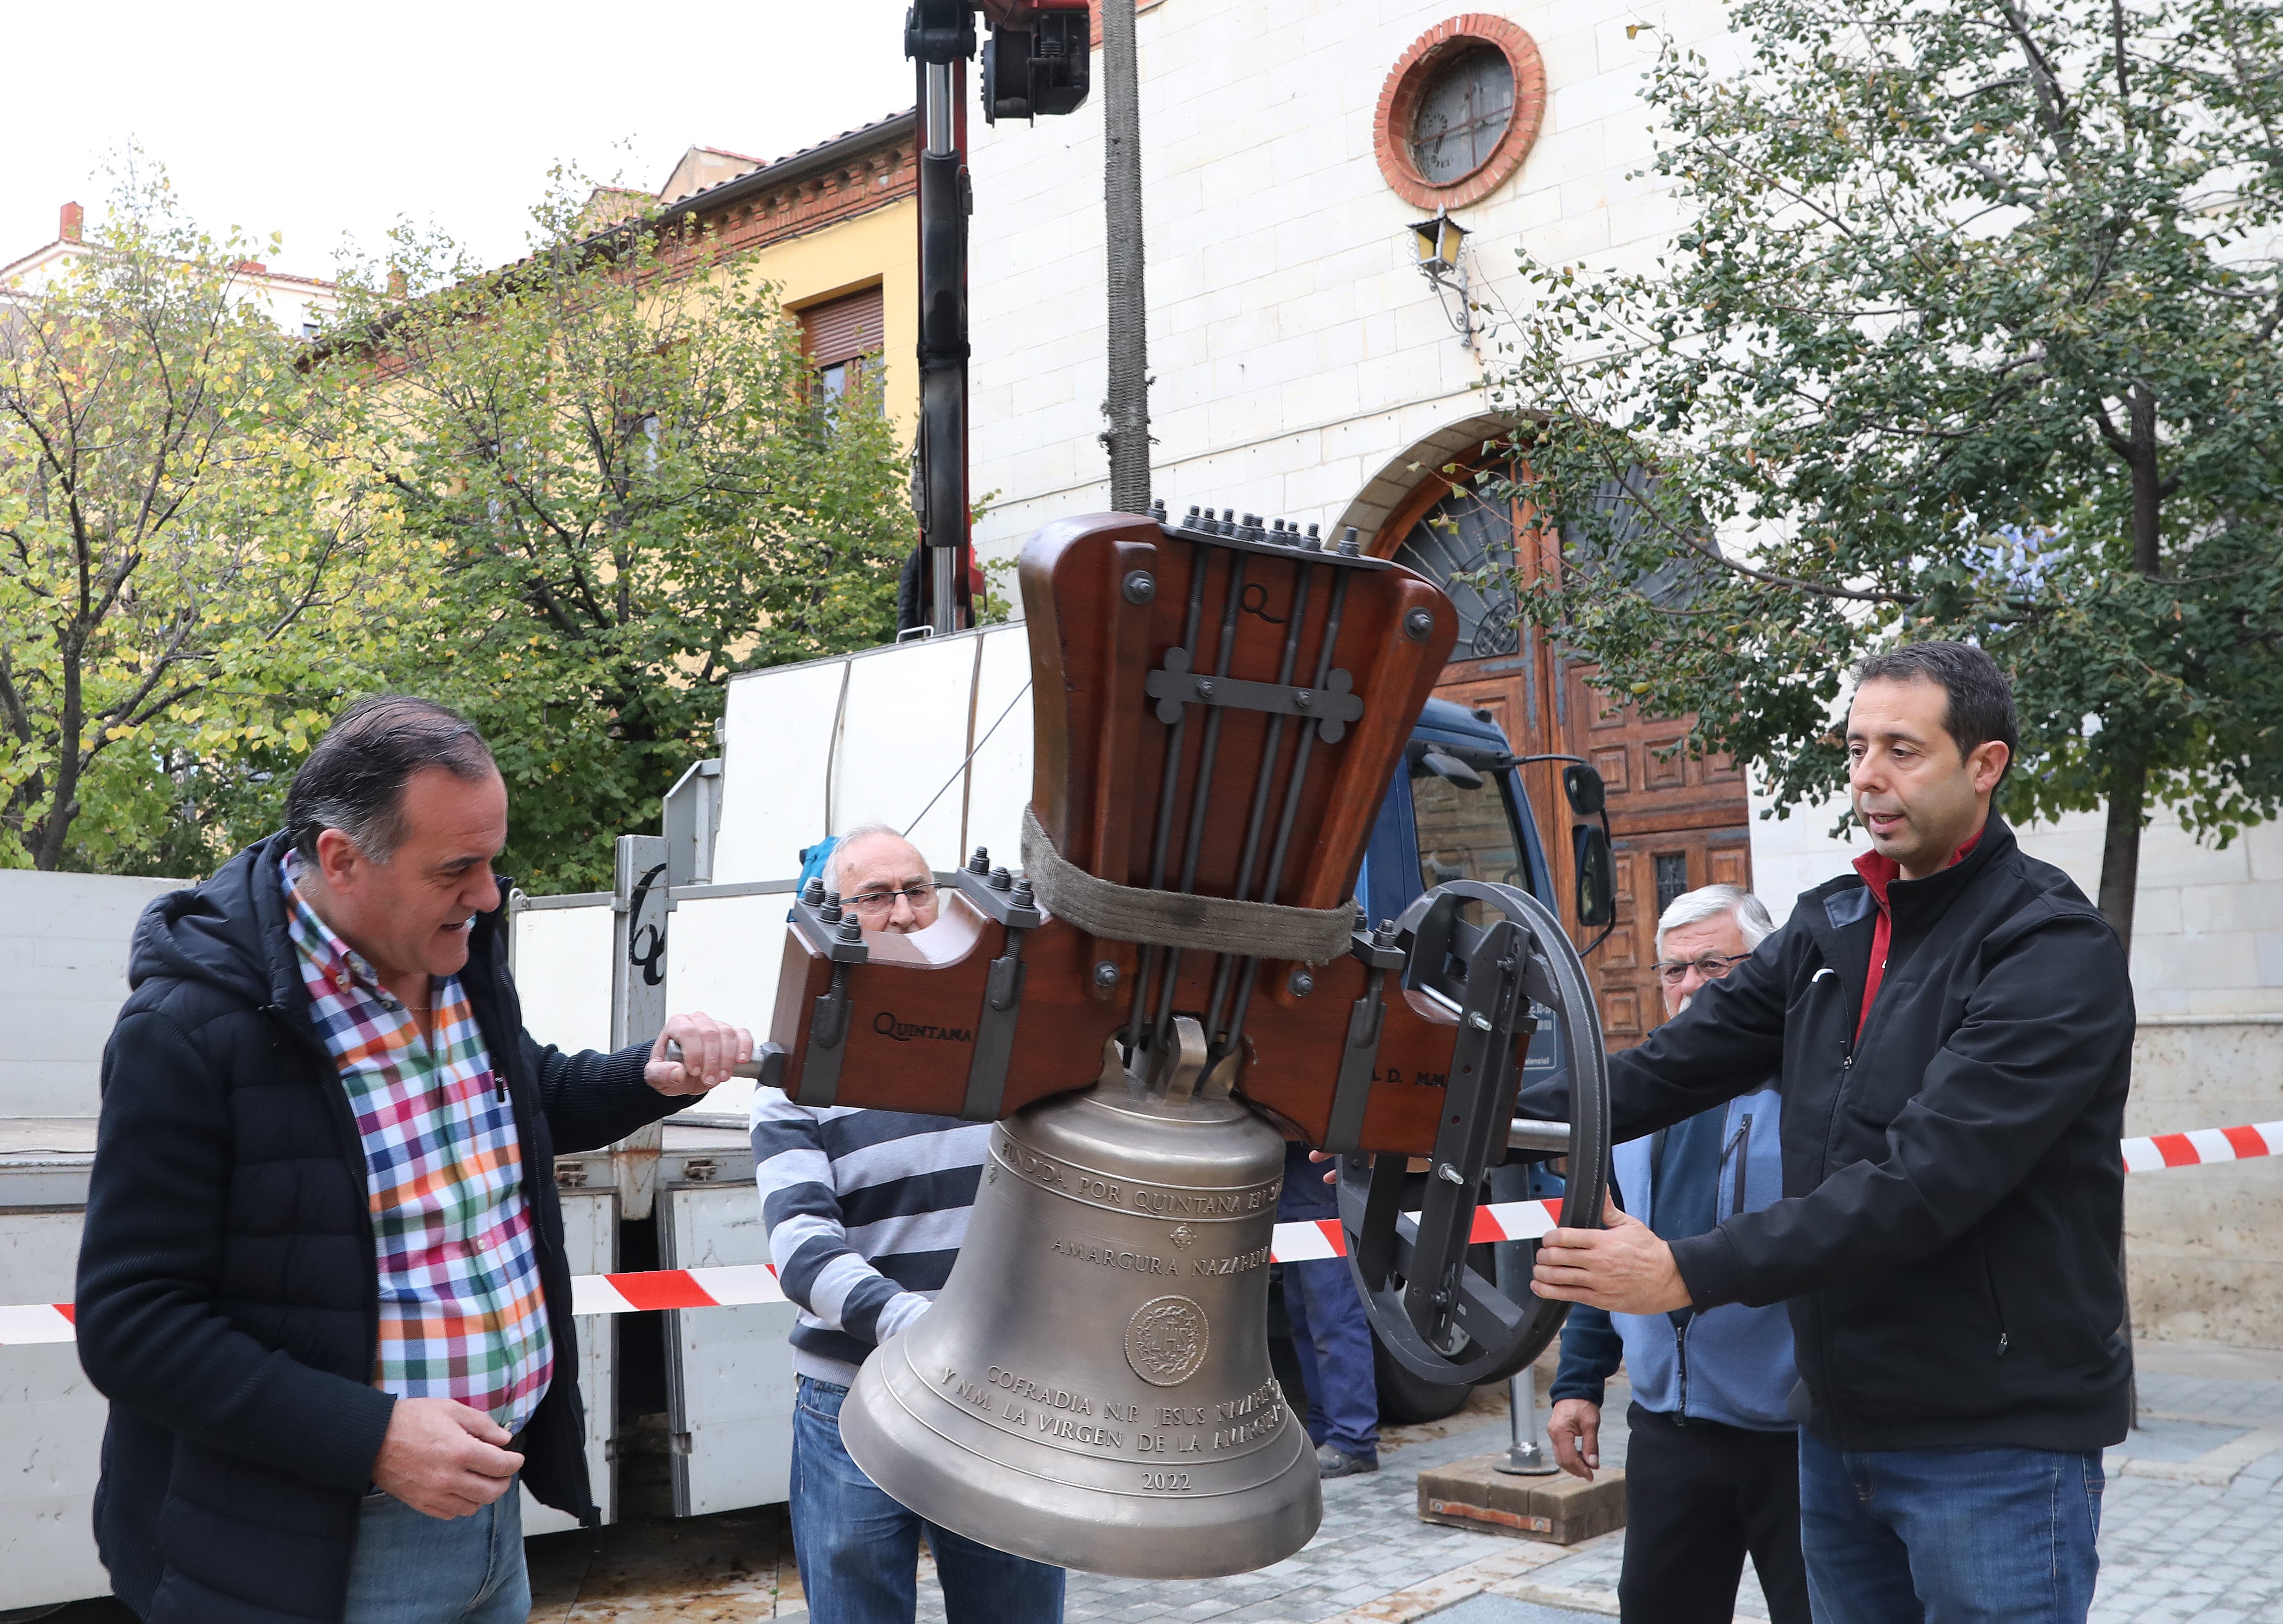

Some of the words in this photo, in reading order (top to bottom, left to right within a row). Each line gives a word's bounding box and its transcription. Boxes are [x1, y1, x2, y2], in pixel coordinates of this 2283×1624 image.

[1242, 583, 1285, 623] Q
[1414, 1071, 1451, 1088] MM
[1078, 1176, 1121, 1203] POR
[1132, 1190, 1240, 1214] QUINTANA
[1050, 1237, 1178, 1276] AMARGURA
[941, 1367, 956, 1384] Y
[1001, 1403, 1027, 1426] LA
[1039, 1414, 1122, 1448] VIRGEN
[1138, 1433, 1165, 1452] DE
[1177, 1435, 1201, 1452] LA
[987, 1365, 1091, 1415] COFRADIA
[1154, 1407, 1205, 1428] JESUS
[1142, 1472, 1192, 1490] 2022
